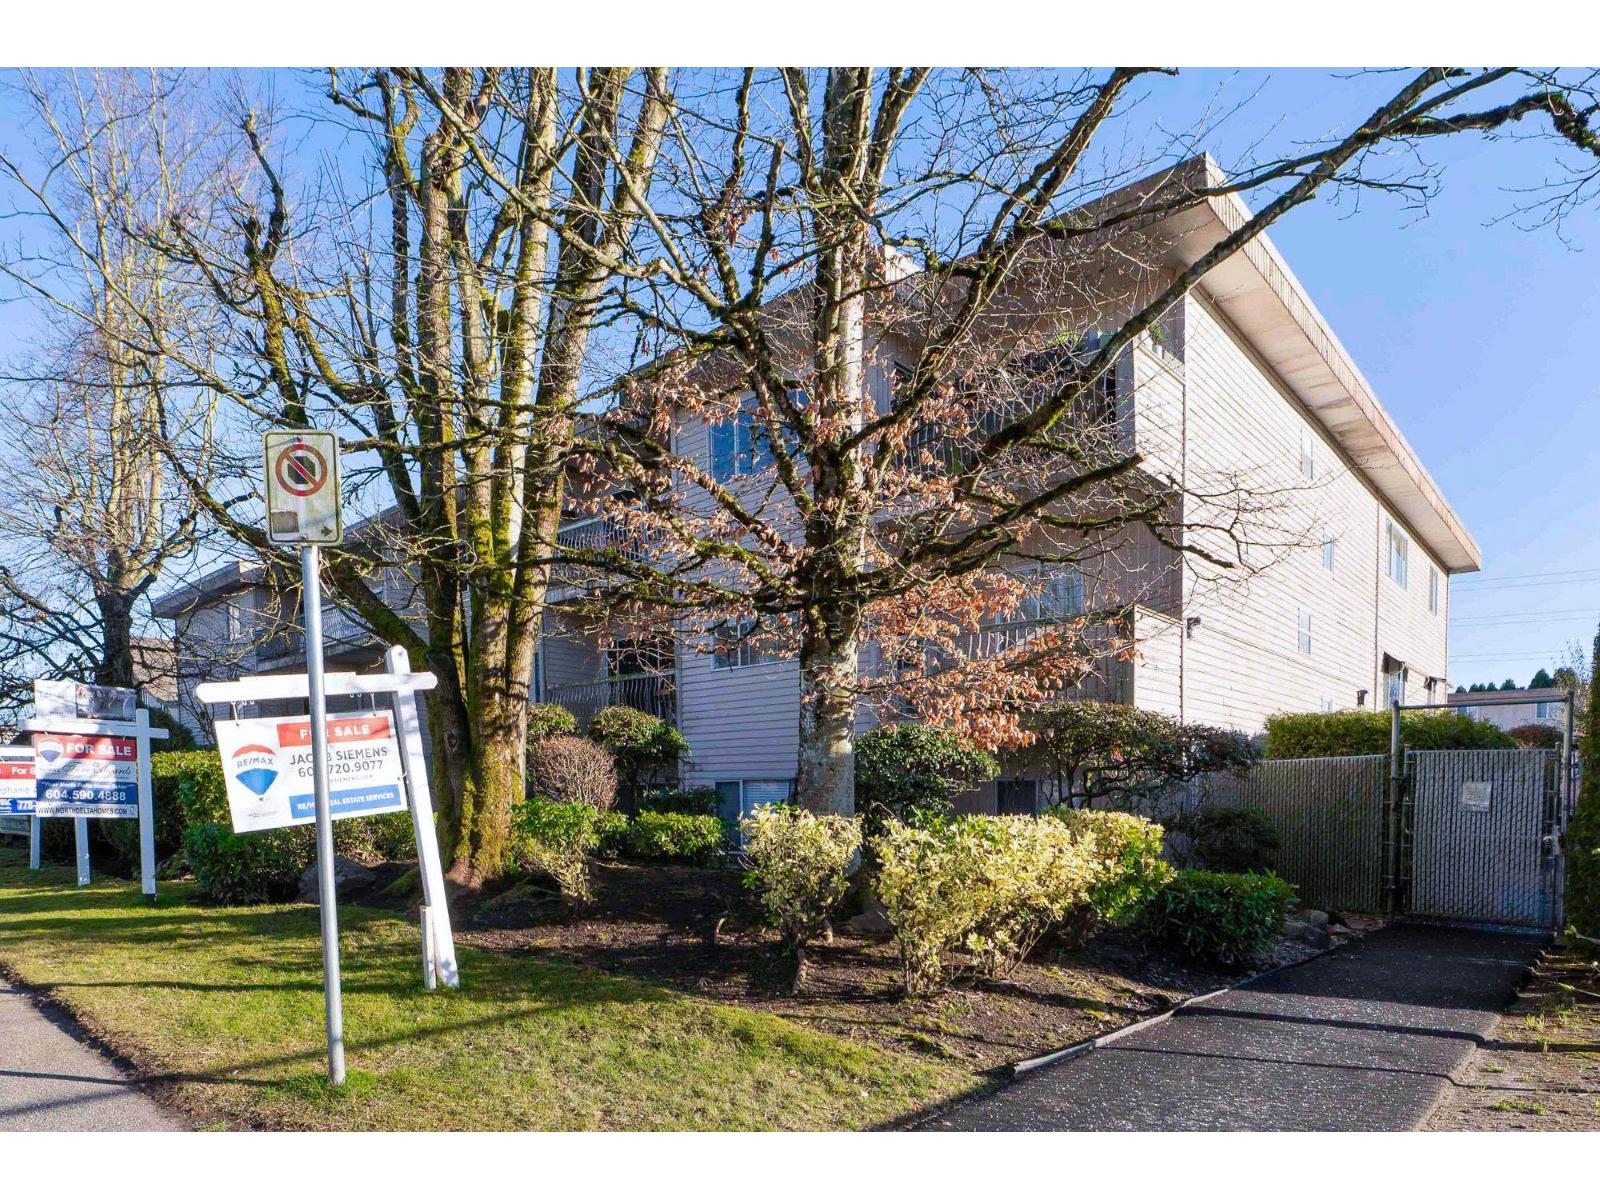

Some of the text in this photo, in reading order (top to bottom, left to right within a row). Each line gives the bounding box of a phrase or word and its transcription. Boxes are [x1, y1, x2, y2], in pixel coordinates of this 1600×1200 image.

[334, 724, 370, 737] SALE
[66, 743, 95, 754] FOR
[98, 745, 132, 757] SALE
[290, 747, 388, 765] JACB SIEMENS
[237, 757, 274, 768] RE/MAX
[298, 760, 383, 777] 60720.9077
[11, 766, 28, 775] For
[45, 789, 126, 801] 604.590.4888
[343, 795, 364, 804] ESTATE
[366, 792, 394, 802] SERVICES
